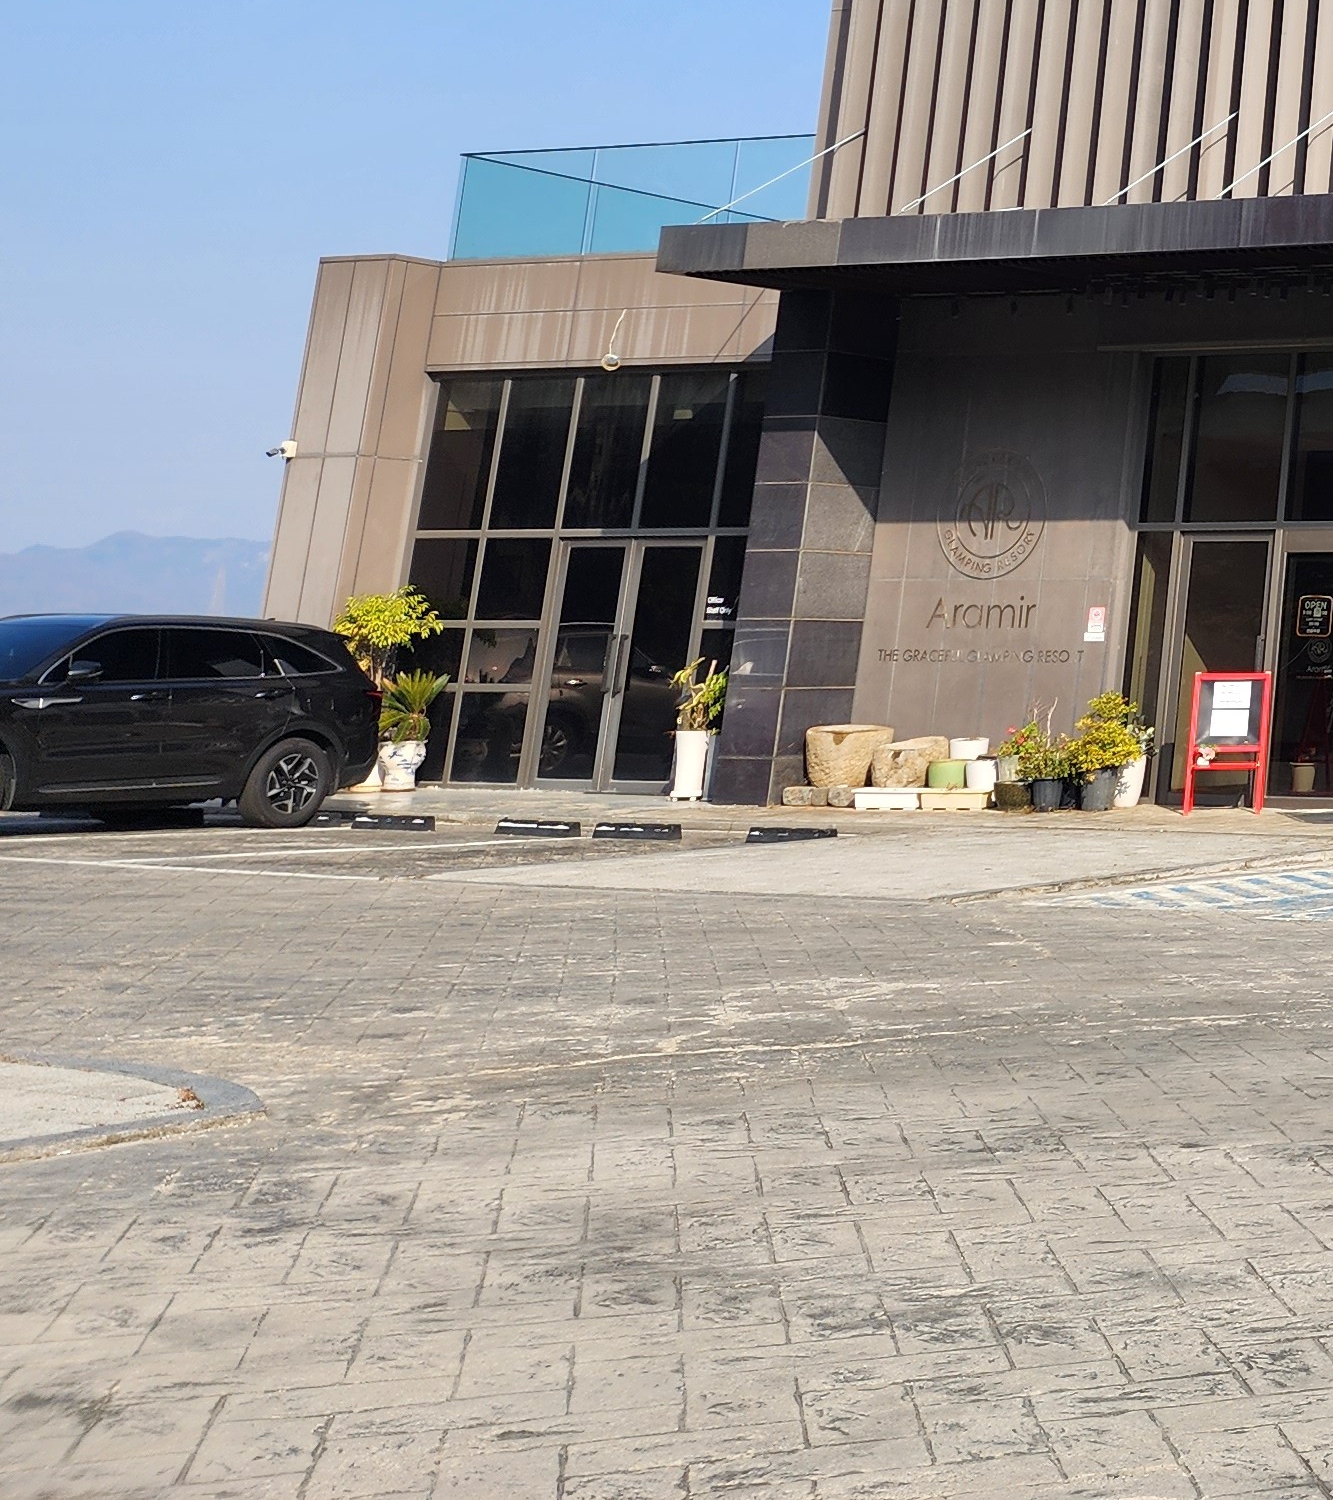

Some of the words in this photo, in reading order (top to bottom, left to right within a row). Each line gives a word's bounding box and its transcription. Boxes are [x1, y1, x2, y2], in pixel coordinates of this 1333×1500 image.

[944, 529, 992, 574] GLAMPING
[997, 530, 1035, 572] RESORT
[926, 595, 1036, 629] Aramir
[1305, 601, 1328, 610] OPEN
[878, 649, 899, 662] THE
[966, 650, 1034, 663] GLAMPNG
[1037, 650, 1085, 663] RESOT
